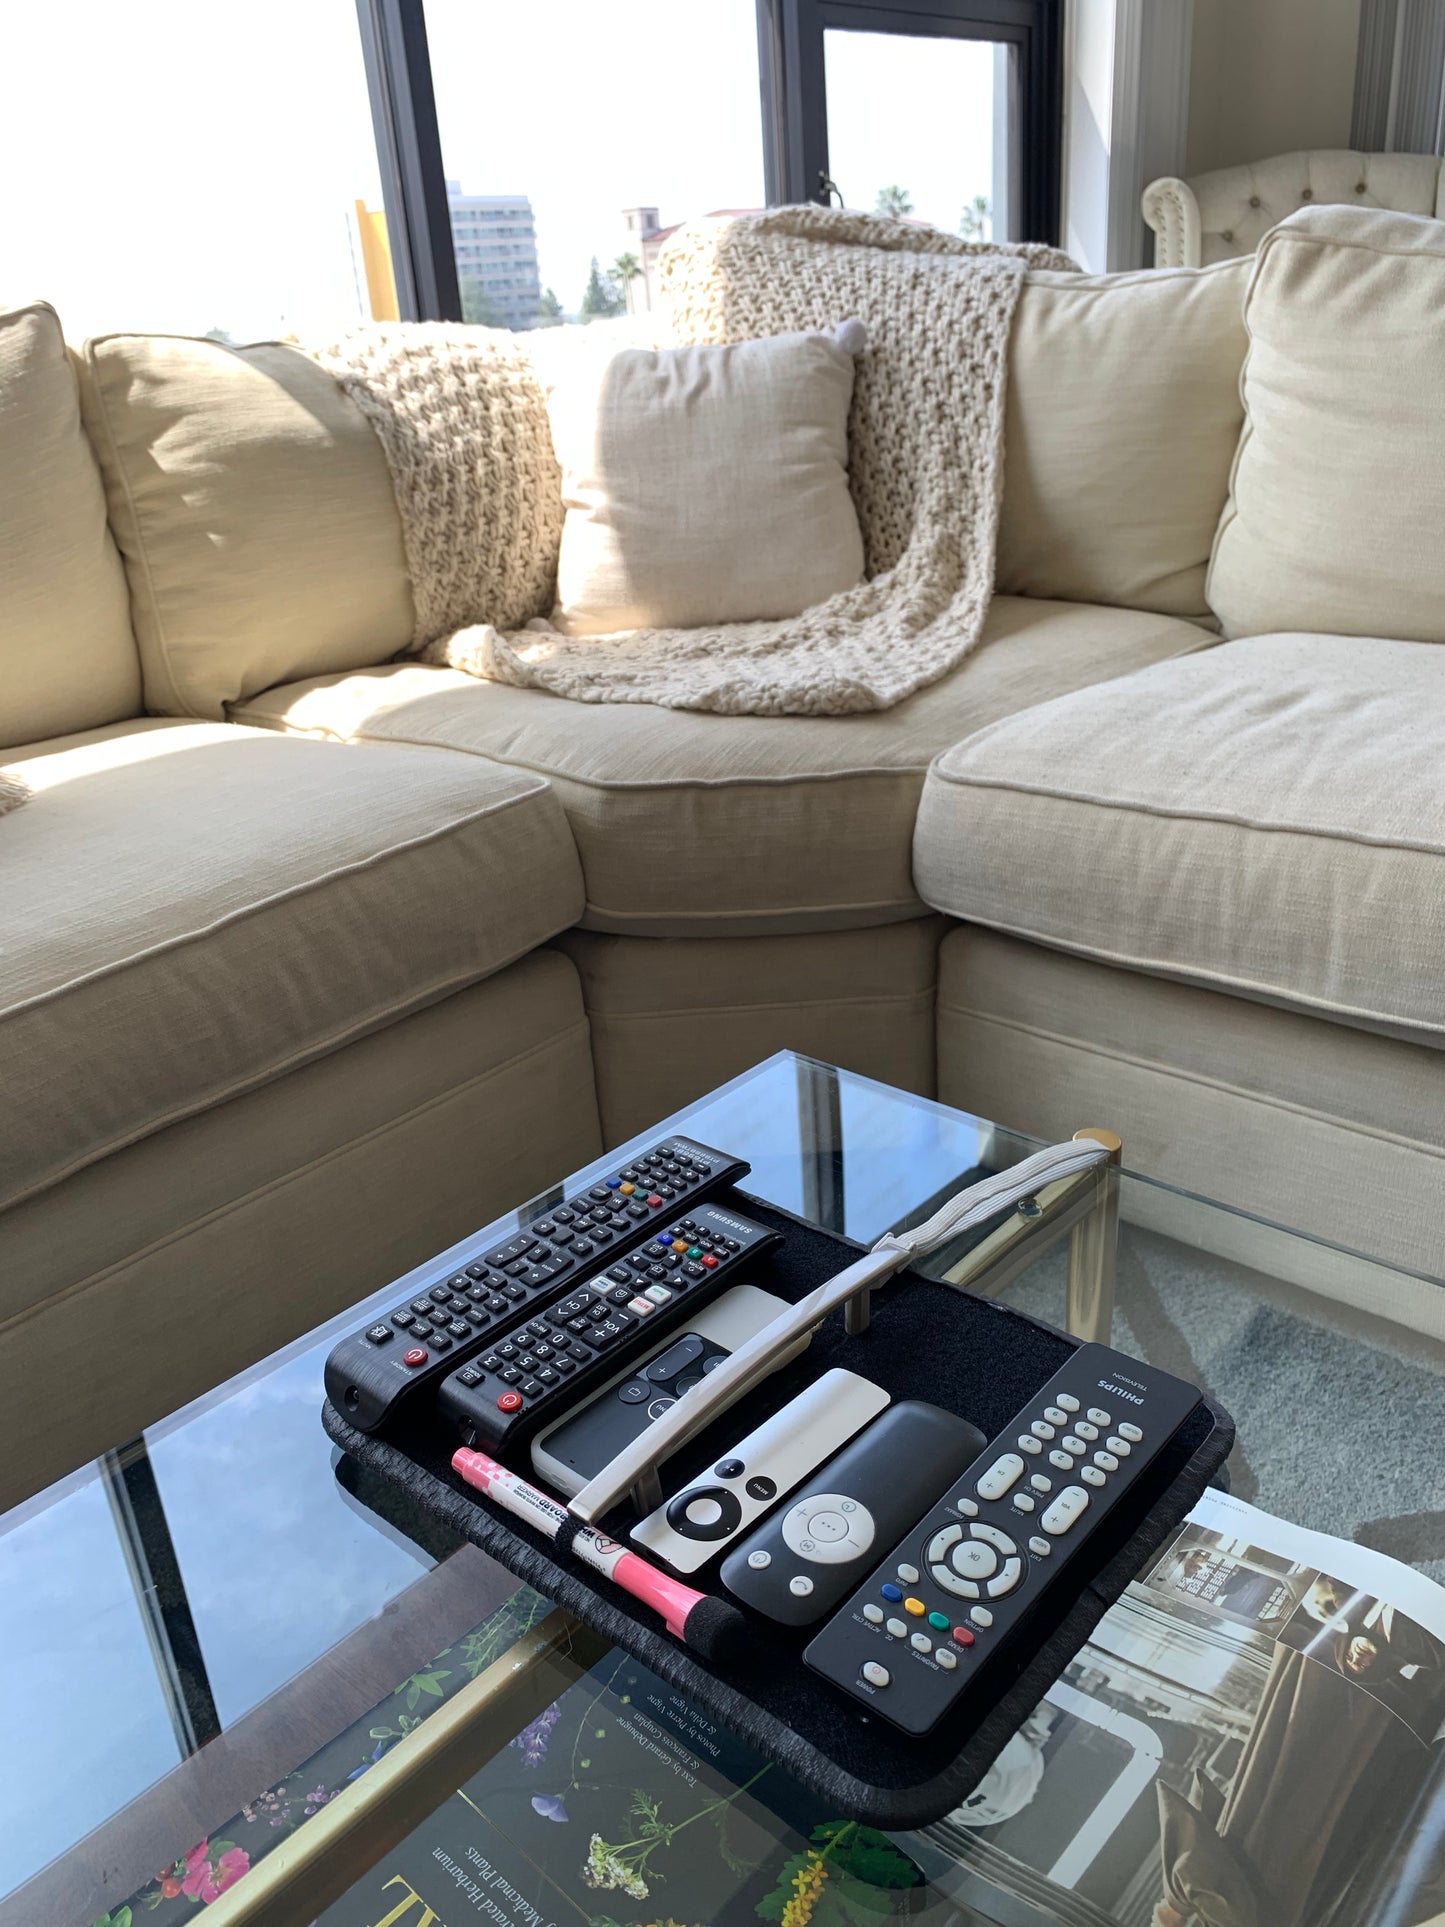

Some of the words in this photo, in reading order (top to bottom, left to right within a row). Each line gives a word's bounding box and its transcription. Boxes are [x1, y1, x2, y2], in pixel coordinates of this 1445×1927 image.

[706, 1210, 753, 1234] SAMSUNG
[688, 1261, 705, 1271] RETURN
[613, 1267, 628, 1277] GUIDE
[435, 1288, 446, 1297] FM
[453, 1299, 464, 1307] AM
[566, 1300, 581, 1310] CH
[595, 1304, 607, 1312] LIST
[433, 1310, 445, 1319] AUX
[414, 1323, 426, 1332] ARC
[531, 1321, 548, 1333] PRE-CH
[602, 1320, 620, 1334] VOL
[434, 1335, 444, 1343] HD
[517, 1334, 529, 1343] 9
[552, 1334, 564, 1343] 0
[501, 1344, 513, 1353] 6
[536, 1345, 549, 1354] 8
[483, 1356, 497, 1366] 3
[520, 1356, 533, 1366] 5
[555, 1358, 568, 1367] 7
[389, 1360, 412, 1376] STANDBY
[503, 1367, 517, 1378] 2
[540, 1368, 552, 1377] 4
[523, 1380, 535, 1390] 1
[1112, 1372, 1148, 1392] TELEVISION
[1097, 1380, 1145, 1406] PHILIPS
[516, 1485, 540, 1502] MARKER
[753, 1482, 769, 1496] MENU
[944, 1506, 964, 1519] FORMAT
[1008, 1506, 1025, 1516] MUTE
[967, 1551, 981, 1561] OK
[1029, 1552, 1043, 1562] EXIT
[895, 1577, 908, 1587] INFO
[862, 1620, 882, 1633] ACTIVE
[963, 1618, 985, 1633] OPTION
[884, 1633, 894, 1641] CC
[947, 1640, 965, 1654] DEMO
[911, 1650, 940, 1671] FAVORITES
[855, 1679, 876, 1695] POWER
[646, 1694, 666, 1714] Vigne
[669, 1694, 689, 1715] Vigne
[633, 1712, 662, 1739] Couplan
[666, 1710, 688, 1730] Pierre
[616, 1716, 648, 1746] Debuigne
[686, 1725, 697, 1738] by
[706, 1725, 717, 1735] &
[697, 1734, 721, 1757] Photos
[671, 1762, 682, 1775] by
[690, 1760, 700, 1770] &
[681, 1770, 697, 1789] Text
[464, 1846, 497, 1881] Plants
[431, 1847, 486, 1904] Herbarium
[490, 1876, 544, 1927] Medicinal
